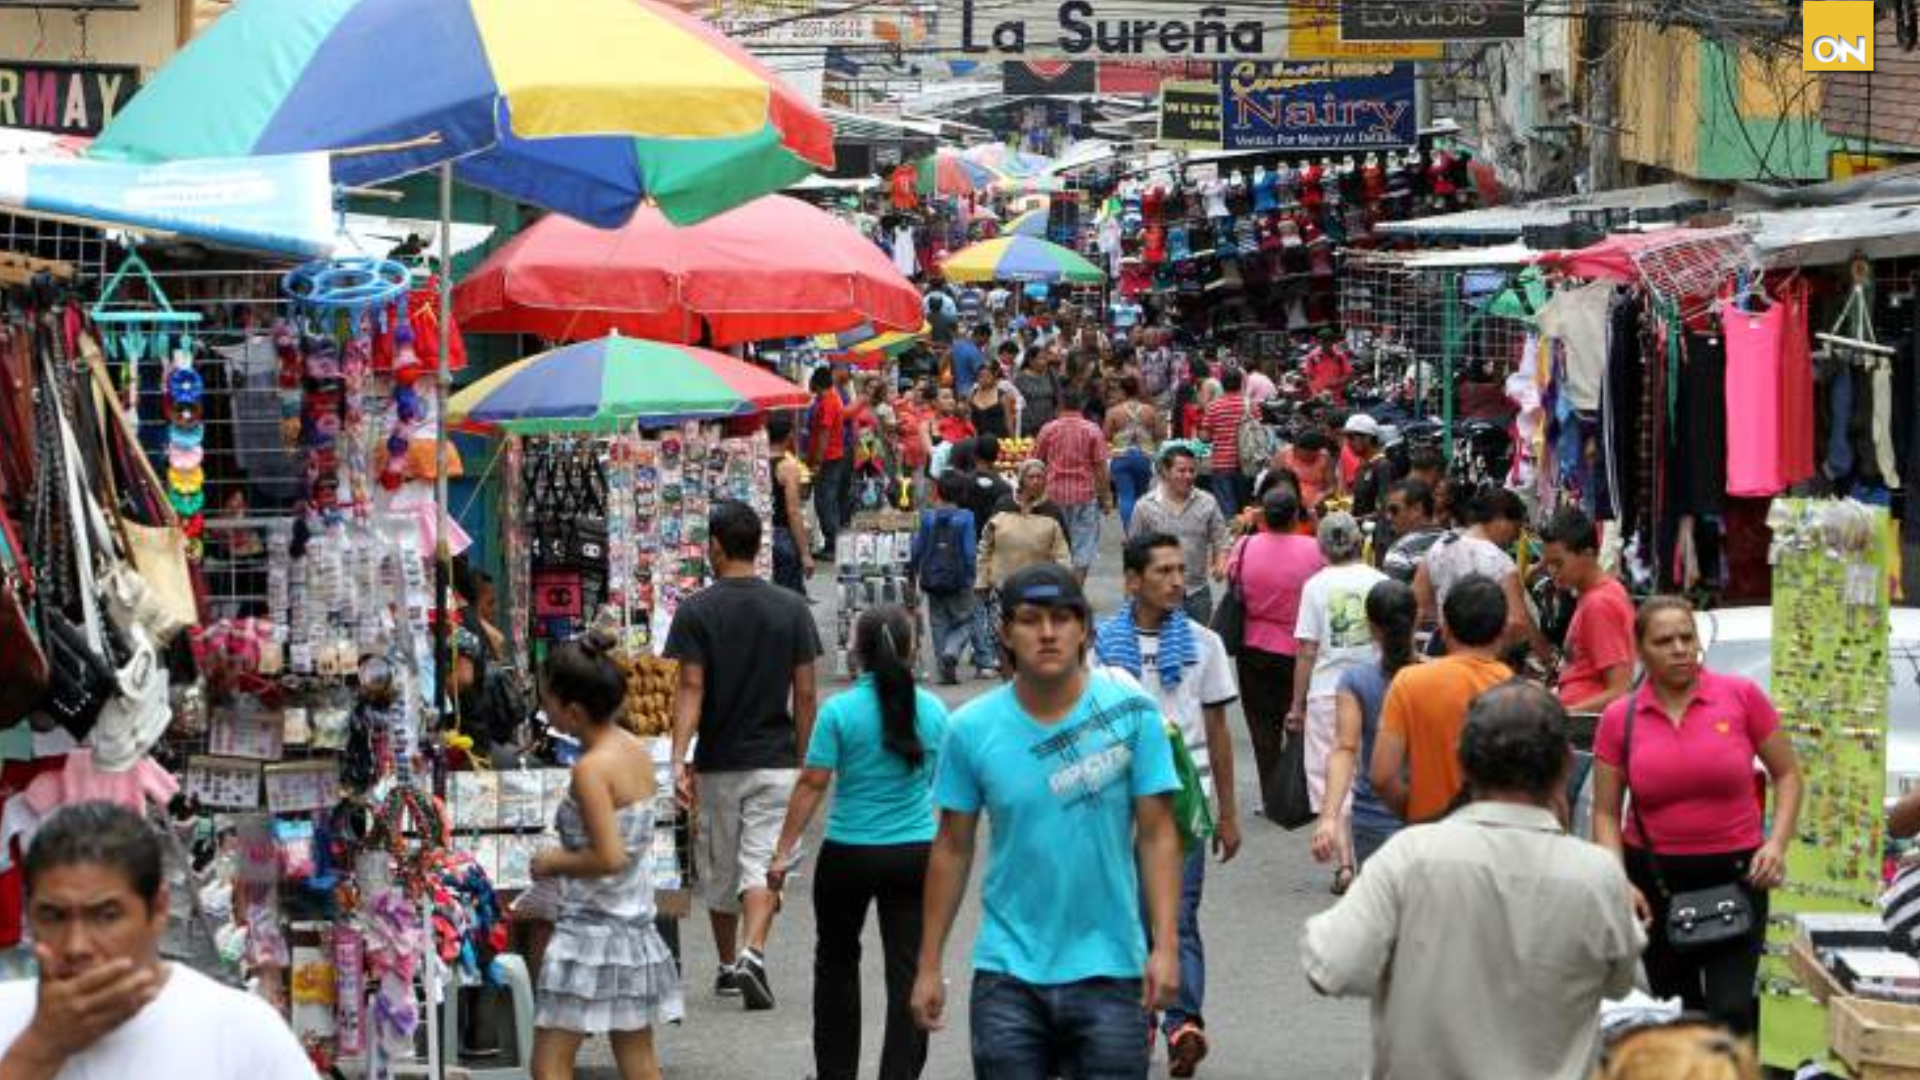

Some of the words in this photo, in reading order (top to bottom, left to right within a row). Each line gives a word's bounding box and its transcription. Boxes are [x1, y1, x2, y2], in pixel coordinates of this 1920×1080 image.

[963, 0, 1025, 53] La
[1058, 0, 1263, 53] Sureña
[0, 69, 122, 127] RMAY
[1232, 92, 1410, 134] Nairy
[1277, 134, 1296, 145] Por
[1332, 135, 1341, 146] y
